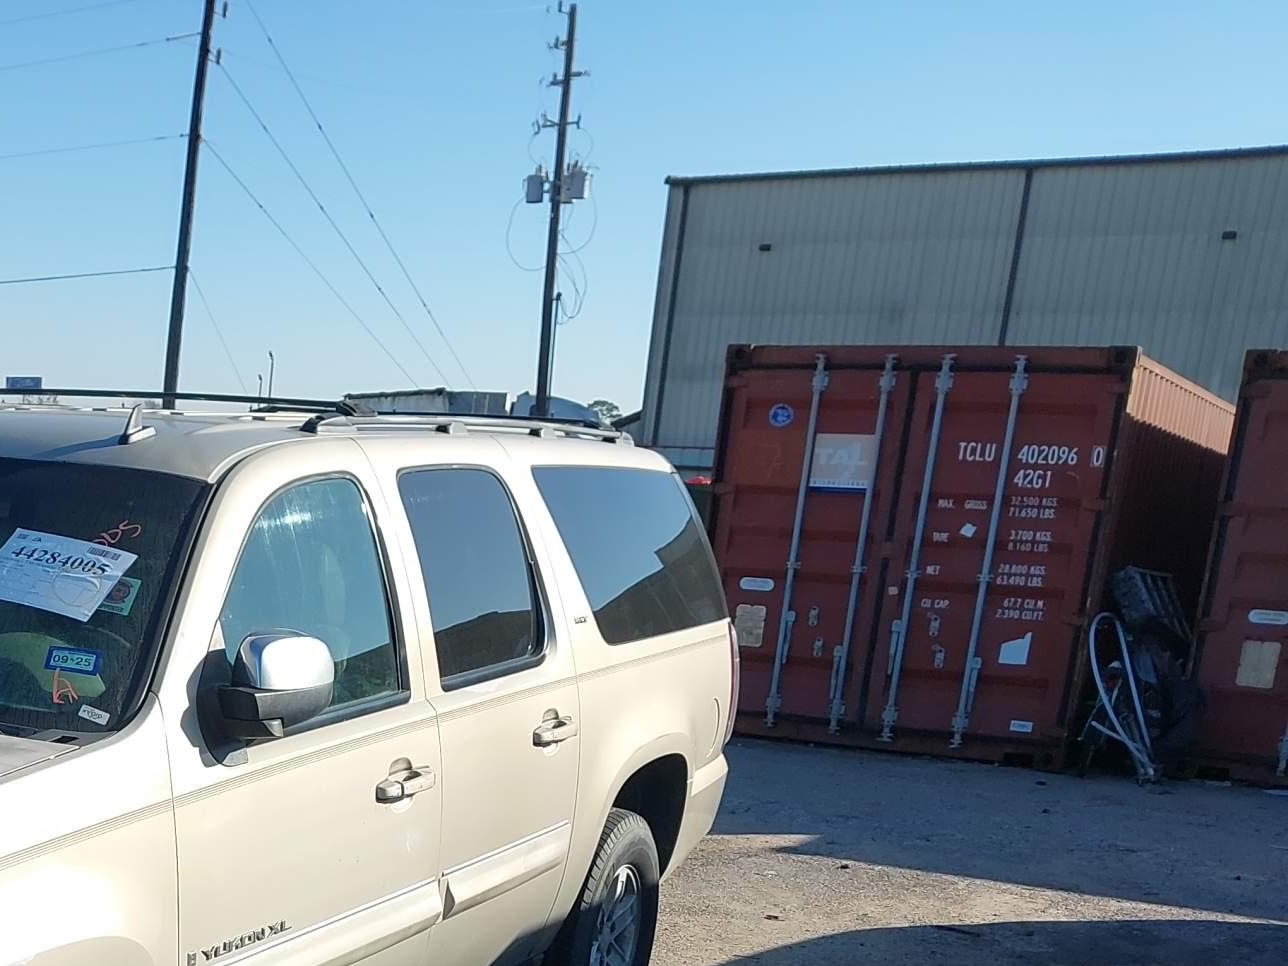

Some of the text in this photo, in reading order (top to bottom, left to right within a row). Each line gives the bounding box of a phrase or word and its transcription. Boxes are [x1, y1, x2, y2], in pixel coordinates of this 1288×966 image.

[958, 442, 997, 462] TCLU
[1017, 444, 1079, 465] 402096
[1013, 469, 1051, 489] 42G1
[12, 545, 112, 576] 44284005
[926, 565, 941, 576] NET
[201, 927, 265, 961] YUKON
[267, 920, 292, 938] XL
